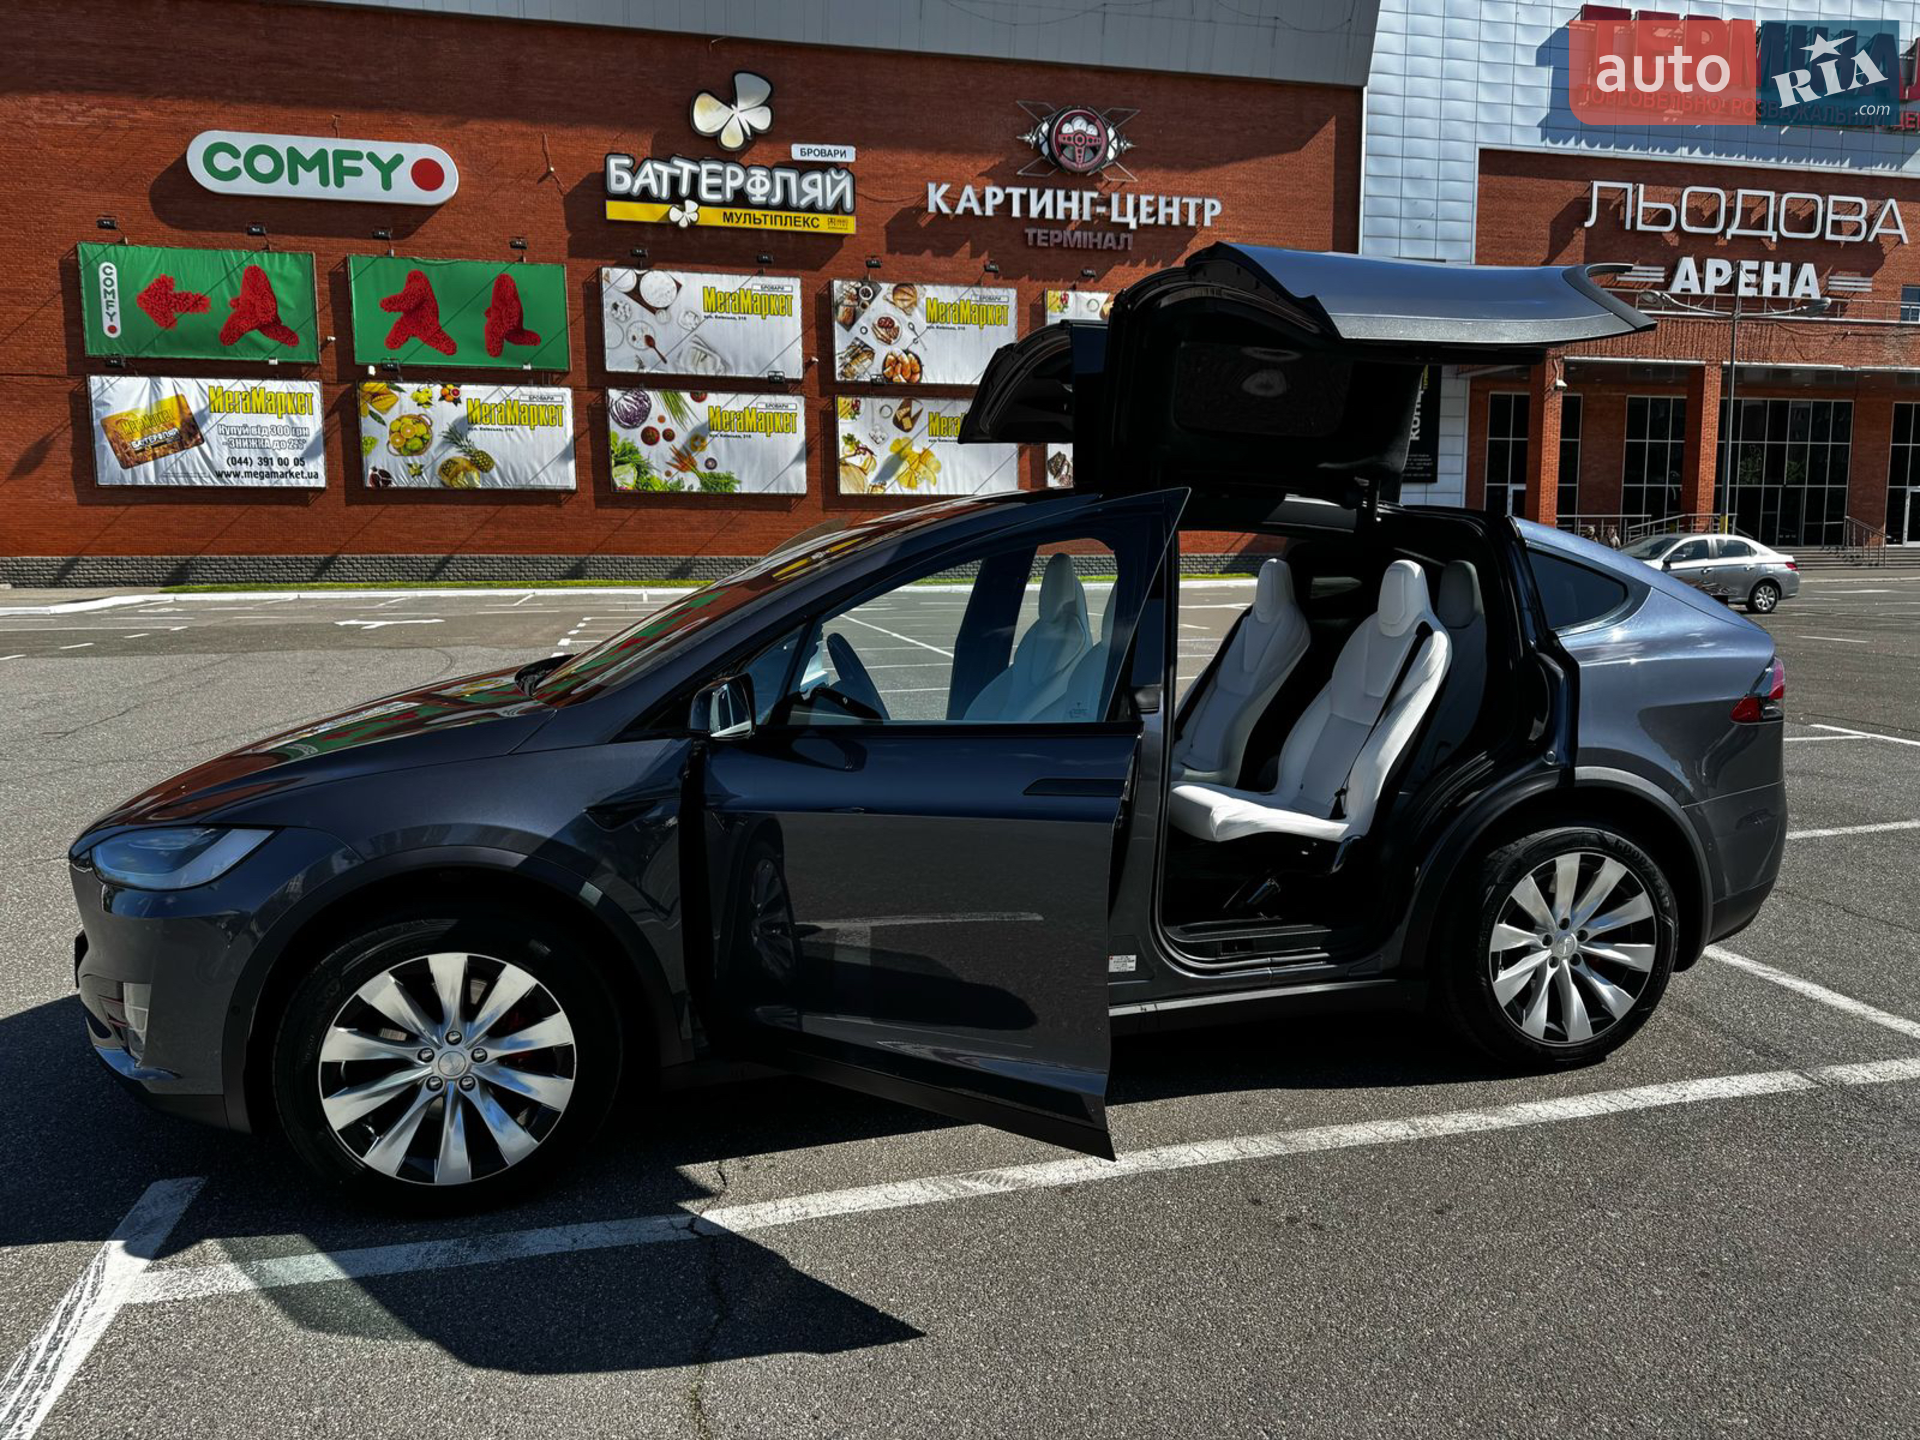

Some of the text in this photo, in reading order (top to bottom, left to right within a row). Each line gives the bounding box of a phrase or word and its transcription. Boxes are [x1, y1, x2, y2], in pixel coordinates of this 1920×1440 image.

[202, 141, 405, 192] COMFY
[799, 147, 847, 159] БРОВАРИ
[607, 155, 854, 212] БАТТЕРФЛЯЙ
[722, 210, 821, 229] МУЛЬТІПЛЕКС
[926, 181, 1223, 230] КАРТИНГ-ЦЕНТР
[1583, 180, 1909, 244] ЛЬОДОВА
[1024, 227, 1134, 251] ТЕРМІНАЛ
[102, 265, 117, 322] COMFY
[1669, 256, 1821, 299] АРЕНА
[702, 286, 793, 320] МегаМаркет
[925, 297, 1010, 330] МегаМаркет
[208, 385, 314, 418] МегаМаркет
[466, 398, 564, 431] МегаМаркет
[217, 424, 249, 437] Купуй
[251, 425, 269, 437] від
[269, 425, 290, 437] 300
[707, 405, 797, 437] МегаМаркет
[226, 456, 306, 467] (044) 391 00 05
[272, 440, 287, 451] до
[215, 469, 319, 481] www.megamarket.ua
